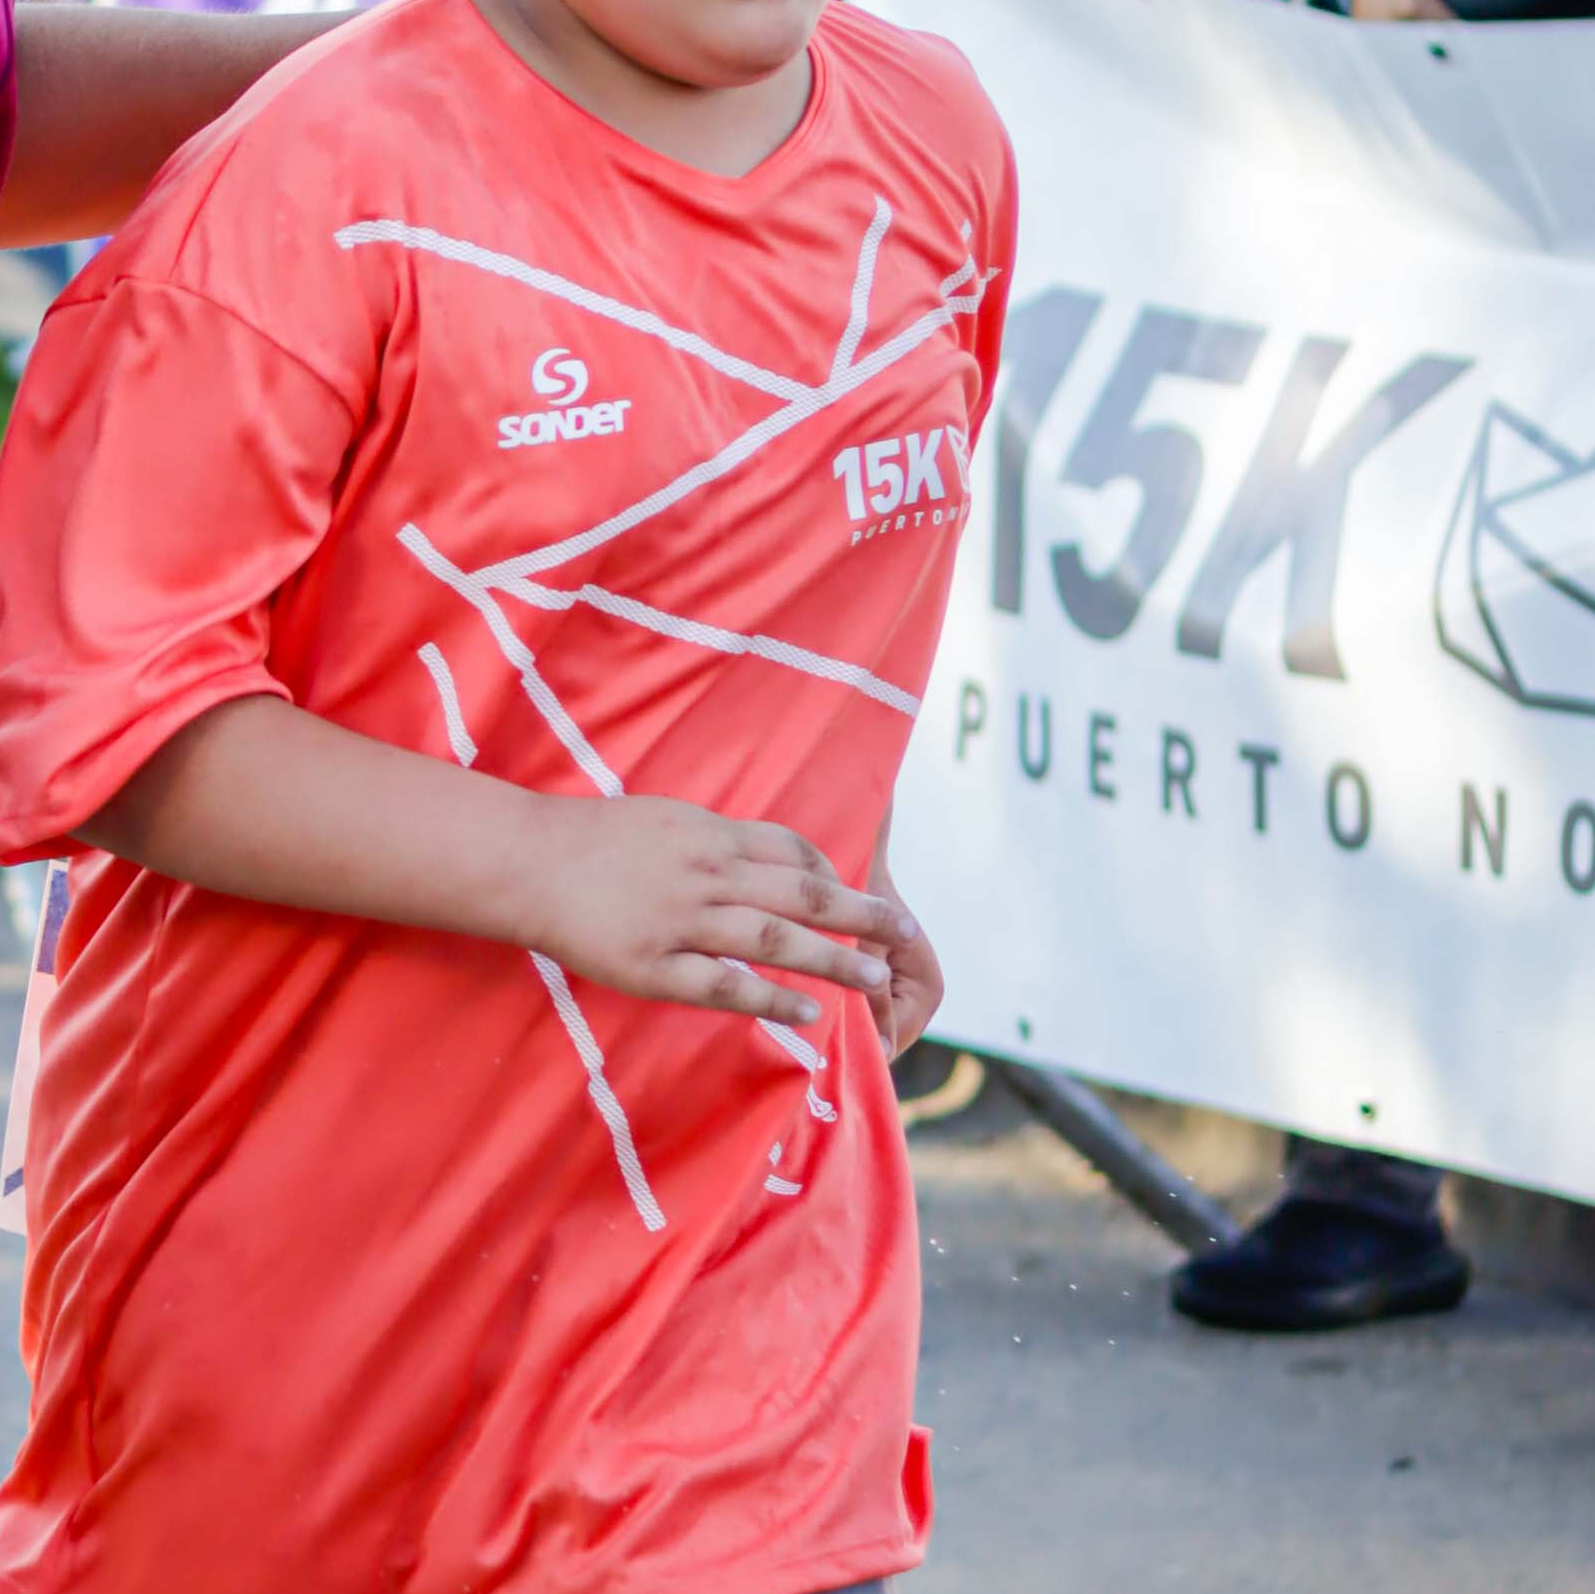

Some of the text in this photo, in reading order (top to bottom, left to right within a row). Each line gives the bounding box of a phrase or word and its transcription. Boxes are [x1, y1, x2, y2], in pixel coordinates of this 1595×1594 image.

[832, 428, 945, 521] 15K
[851, 508, 943, 547] PUERTO
[992, 283, 1478, 683] 15K
[955, 680, 1595, 897] PUERTO NO
